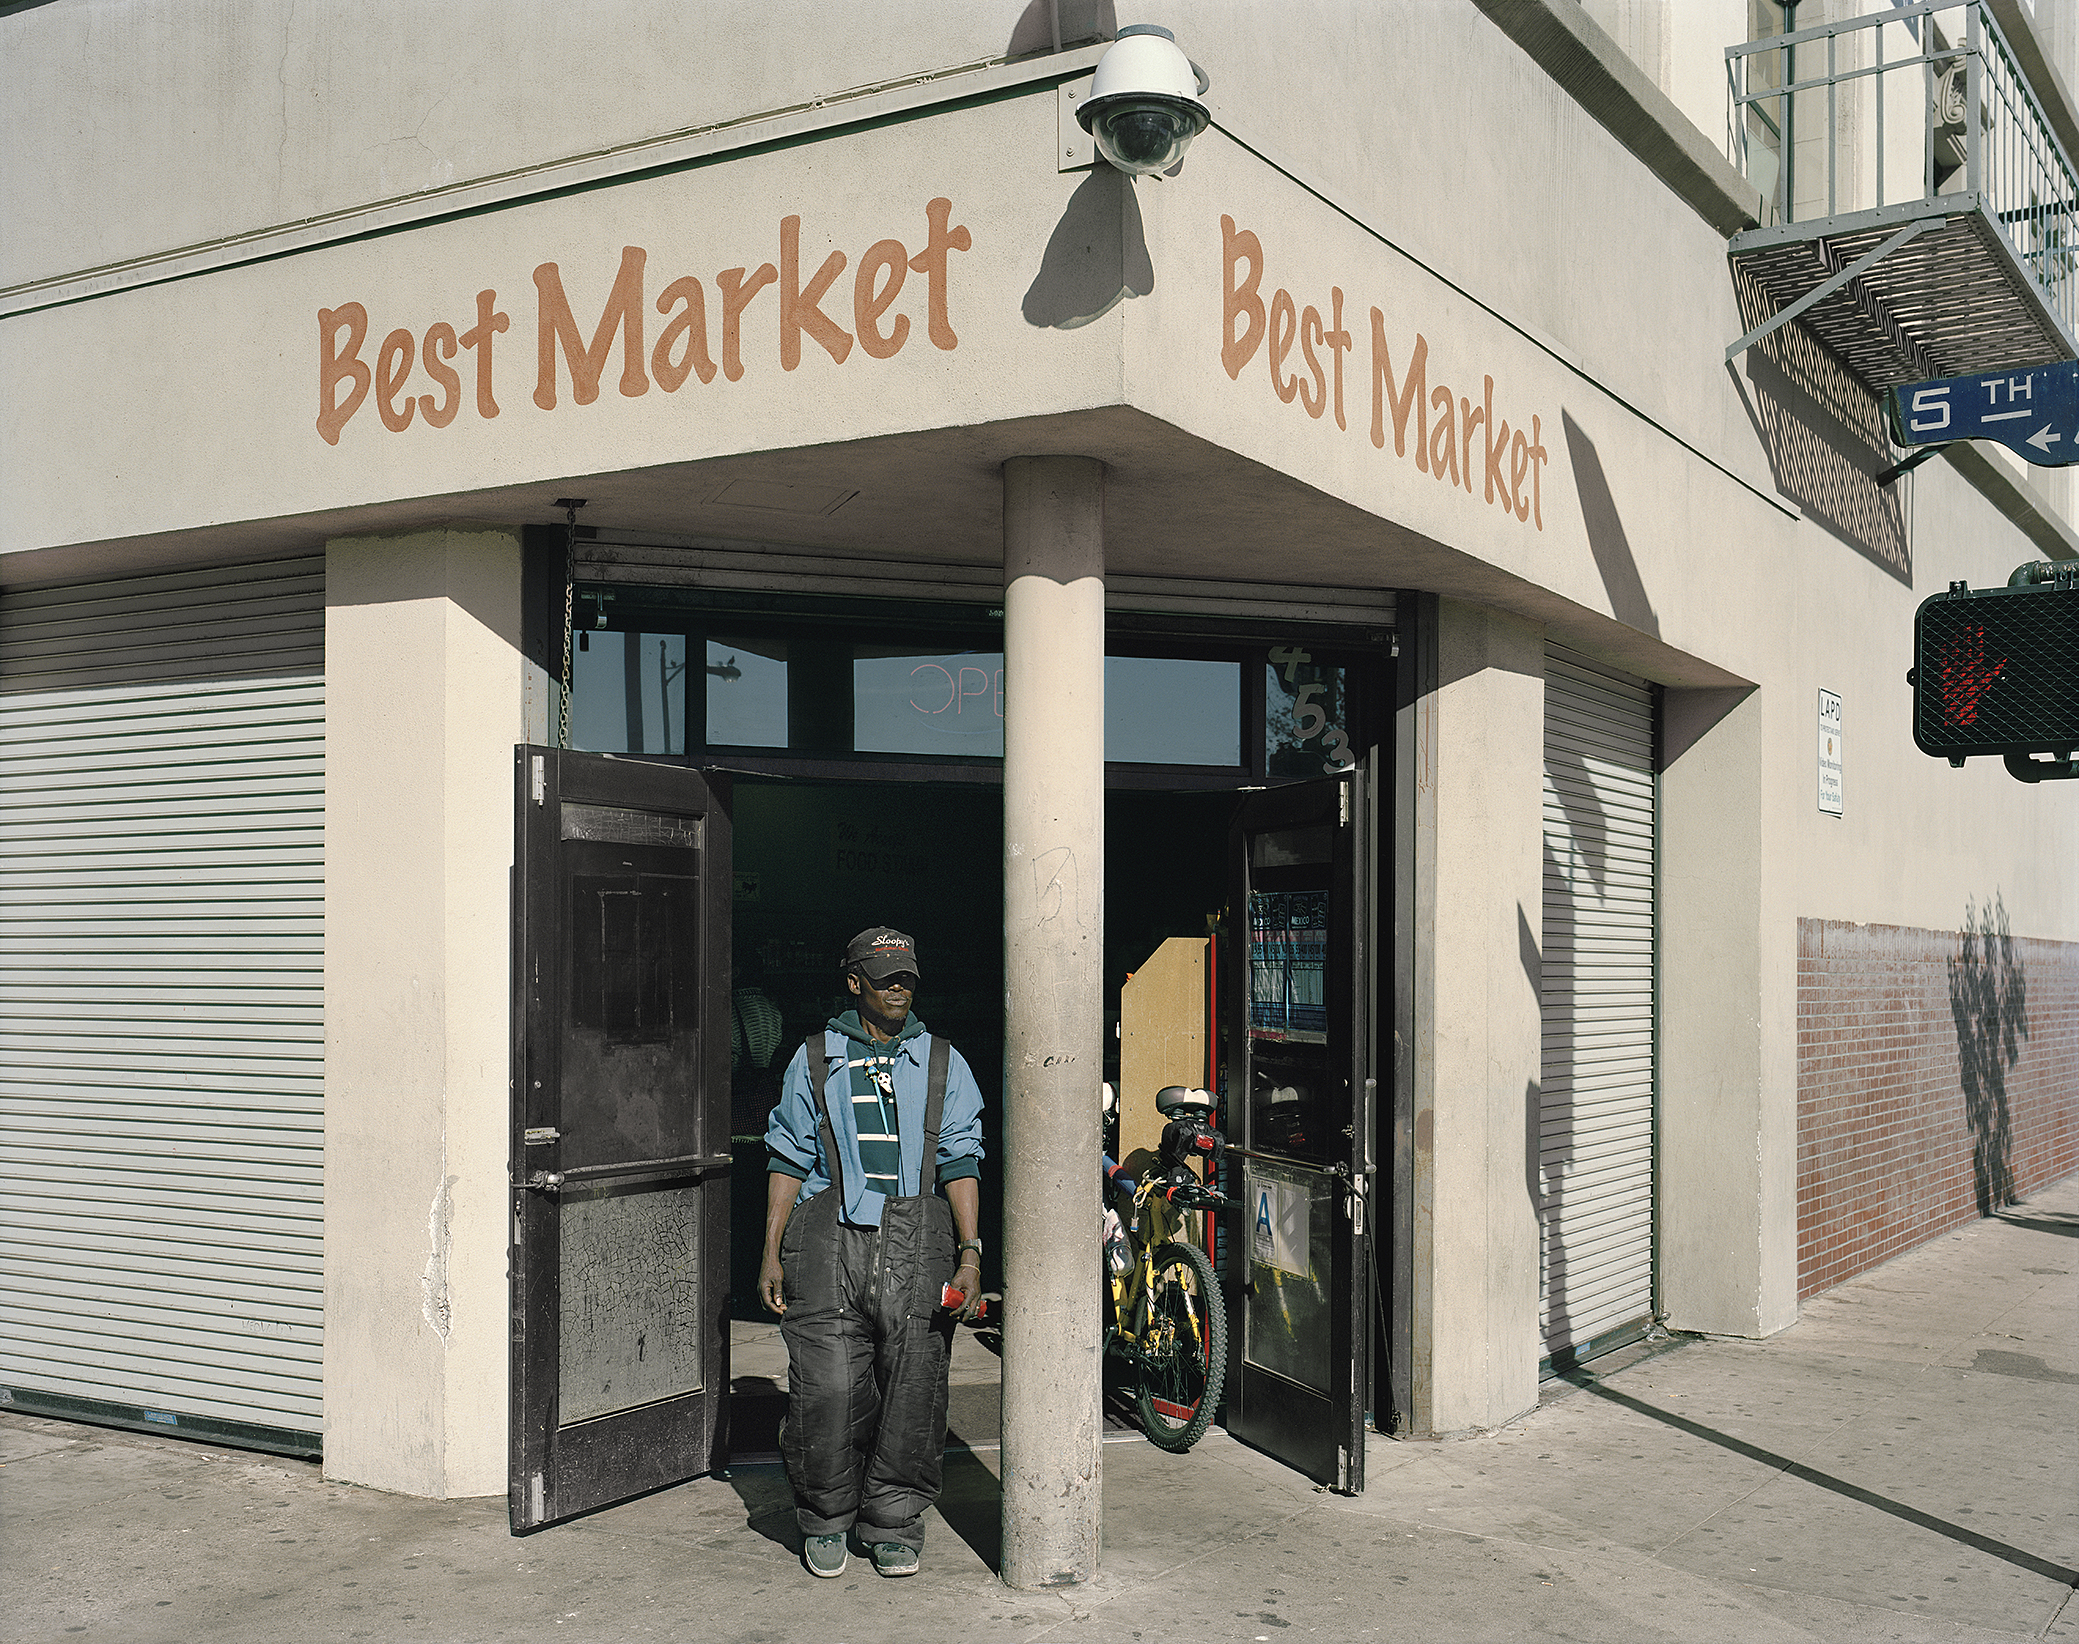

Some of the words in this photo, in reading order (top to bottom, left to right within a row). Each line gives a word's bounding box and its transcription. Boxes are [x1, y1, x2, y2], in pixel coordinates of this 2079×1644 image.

[316, 289, 510, 446] Best
[533, 197, 972, 410] Market
[1221, 214, 1352, 431] Best
[1370, 306, 1547, 531] Market
[1911, 387, 1950, 432] 5
[1981, 375, 2032, 405] TH
[1821, 697, 1840, 721] LAPD
[1255, 1191, 1273, 1237] A
